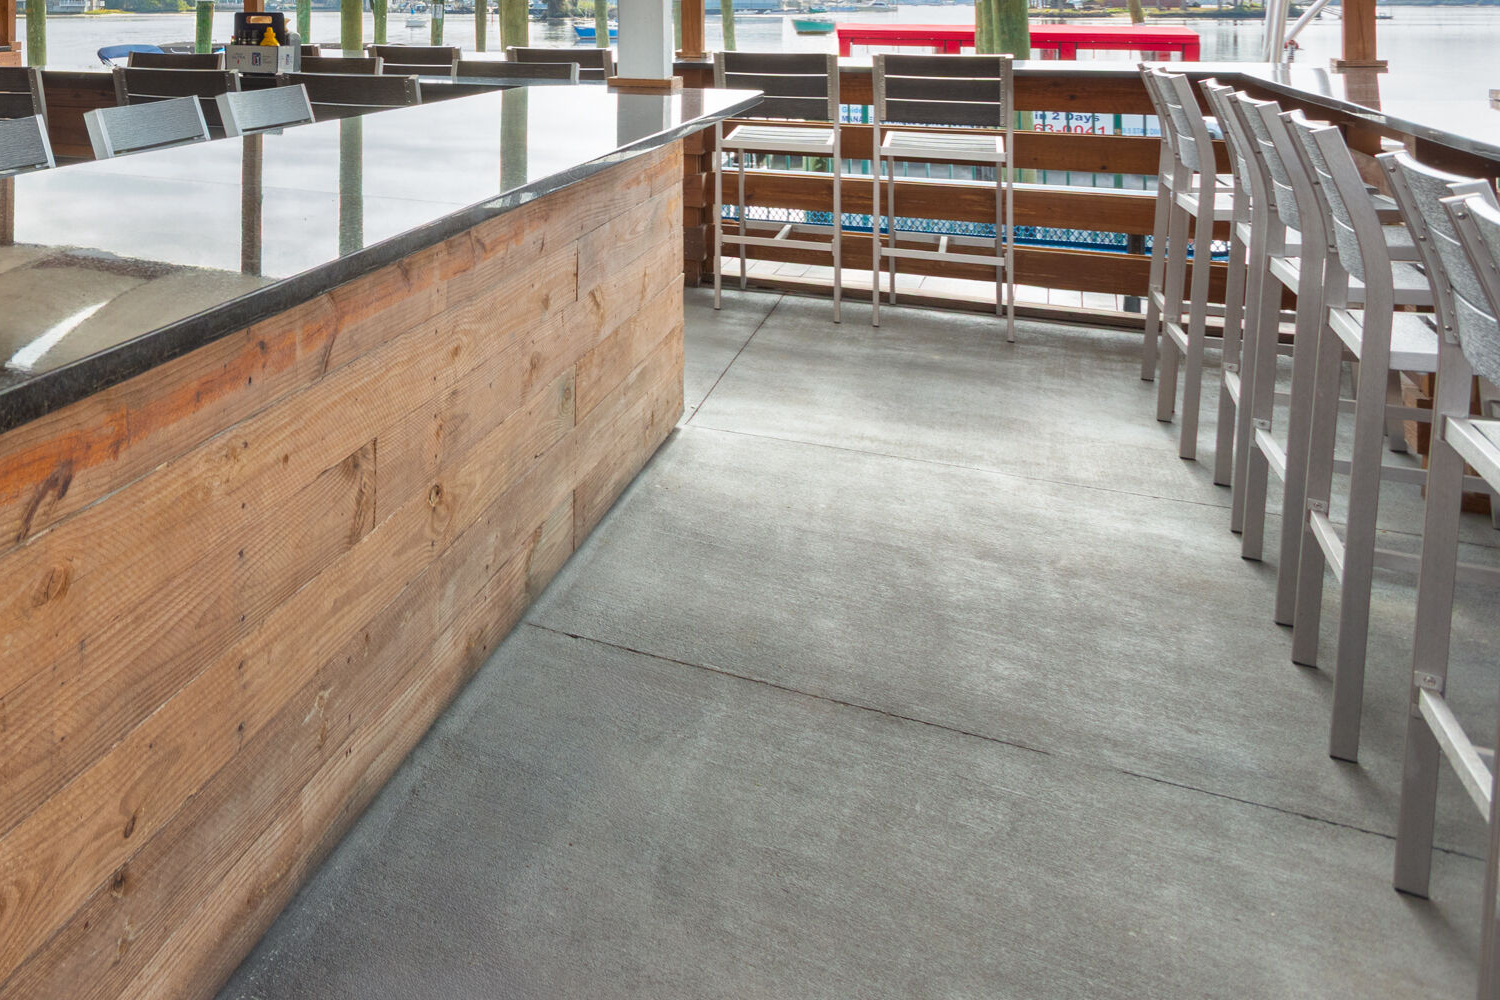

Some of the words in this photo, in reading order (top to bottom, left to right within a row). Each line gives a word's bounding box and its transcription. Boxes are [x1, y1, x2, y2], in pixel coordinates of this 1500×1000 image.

[841, 115, 873, 123] MANAE
[1052, 111, 1060, 120] 2
[1066, 111, 1100, 123] Days
